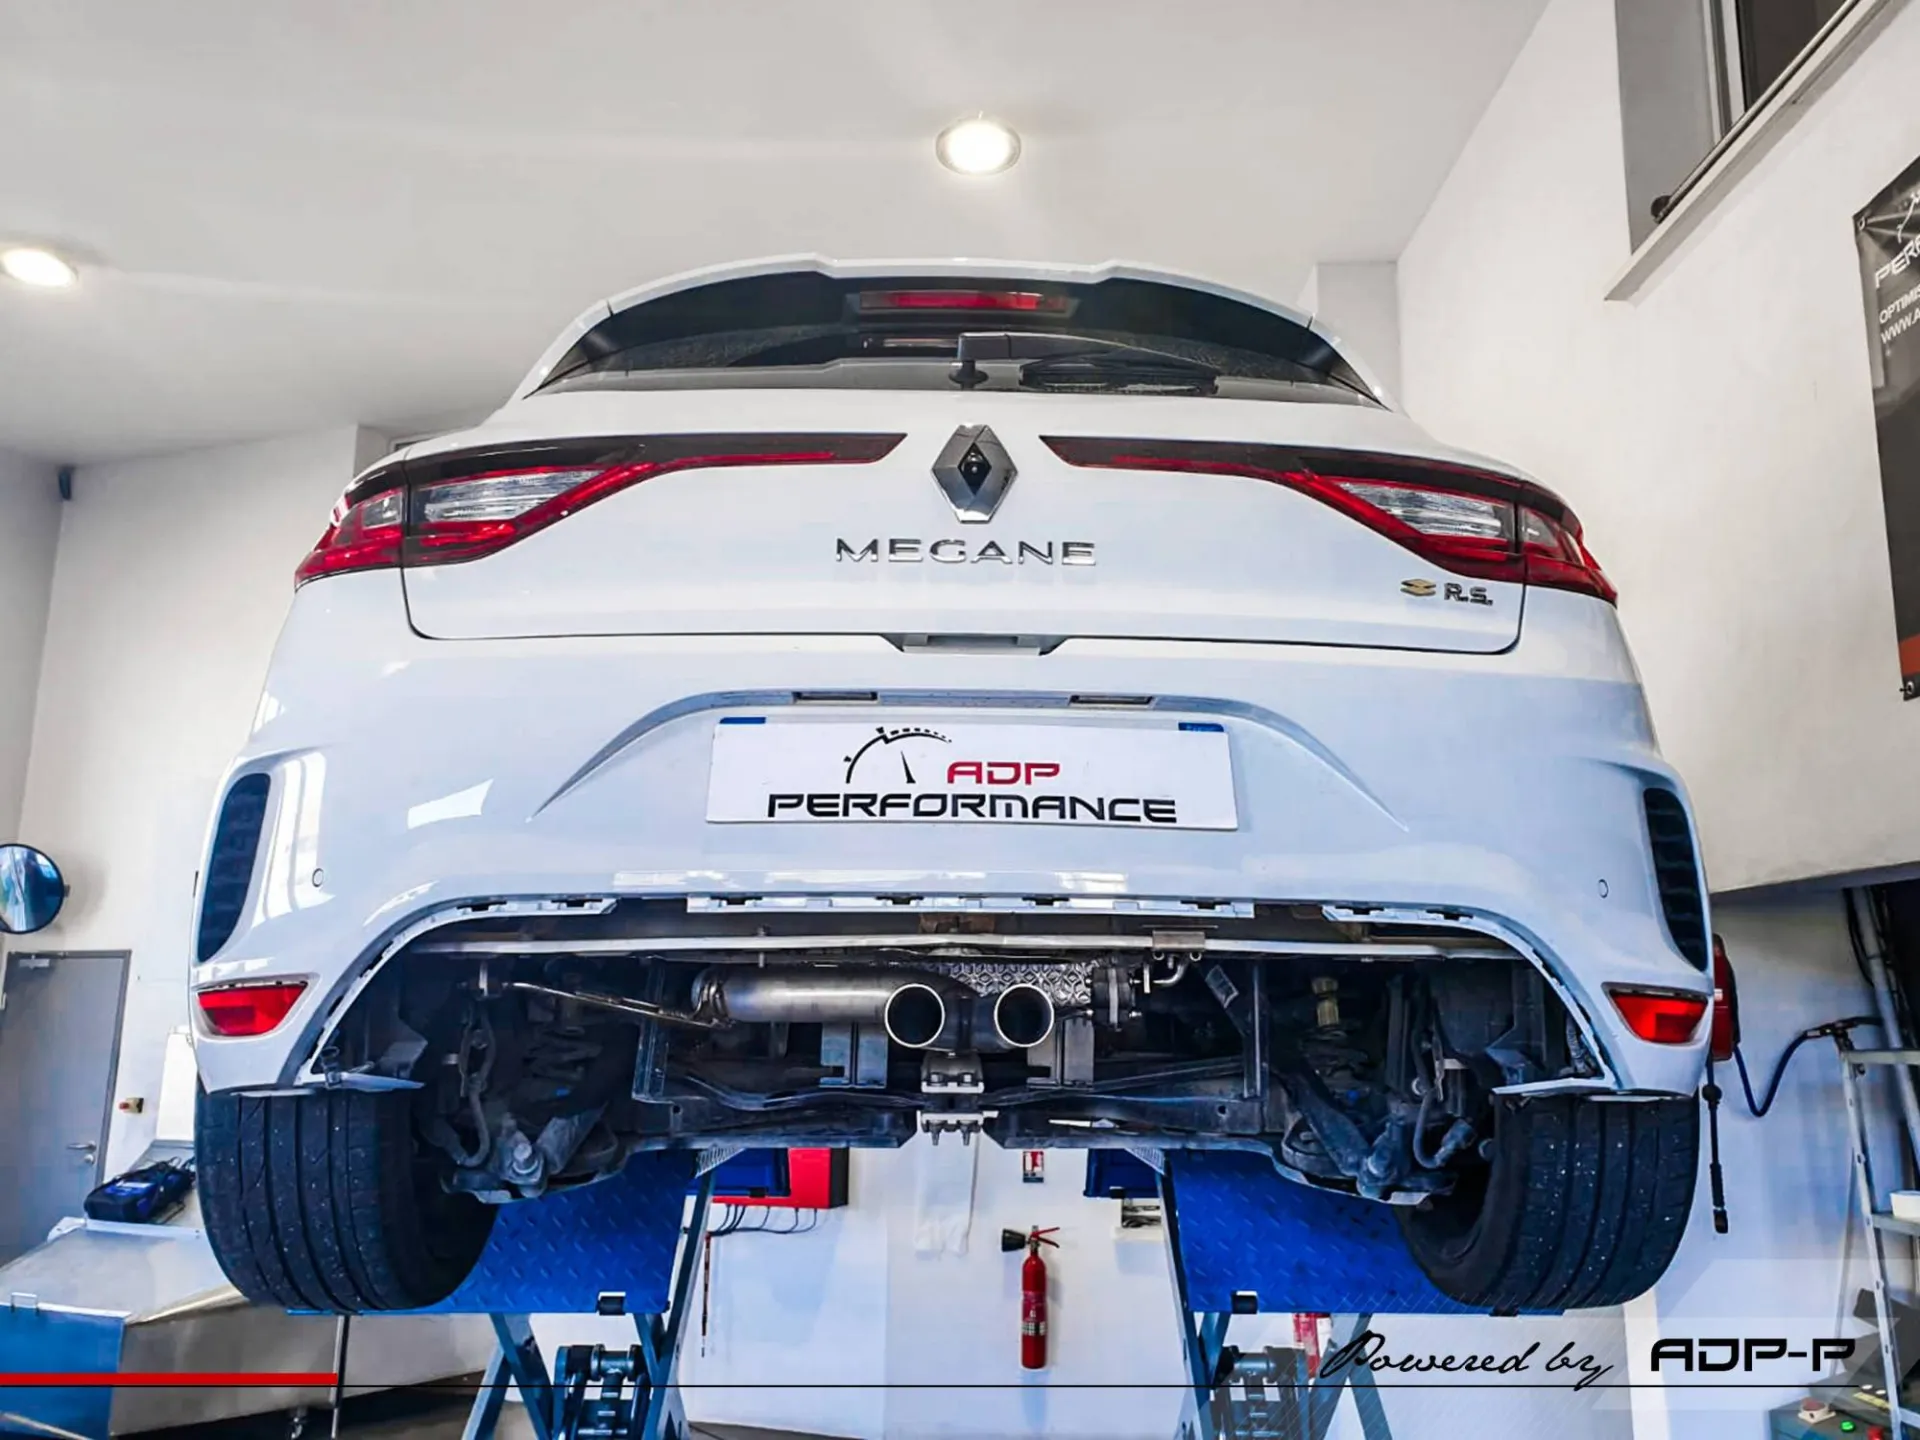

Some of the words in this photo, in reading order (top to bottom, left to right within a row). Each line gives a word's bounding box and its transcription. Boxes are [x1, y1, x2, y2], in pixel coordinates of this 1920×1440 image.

[836, 538, 1096, 566] MEGANE
[1444, 582, 1493, 606] R.S.
[947, 761, 1060, 785] ADP
[768, 793, 1177, 823] PERFORMANCE
